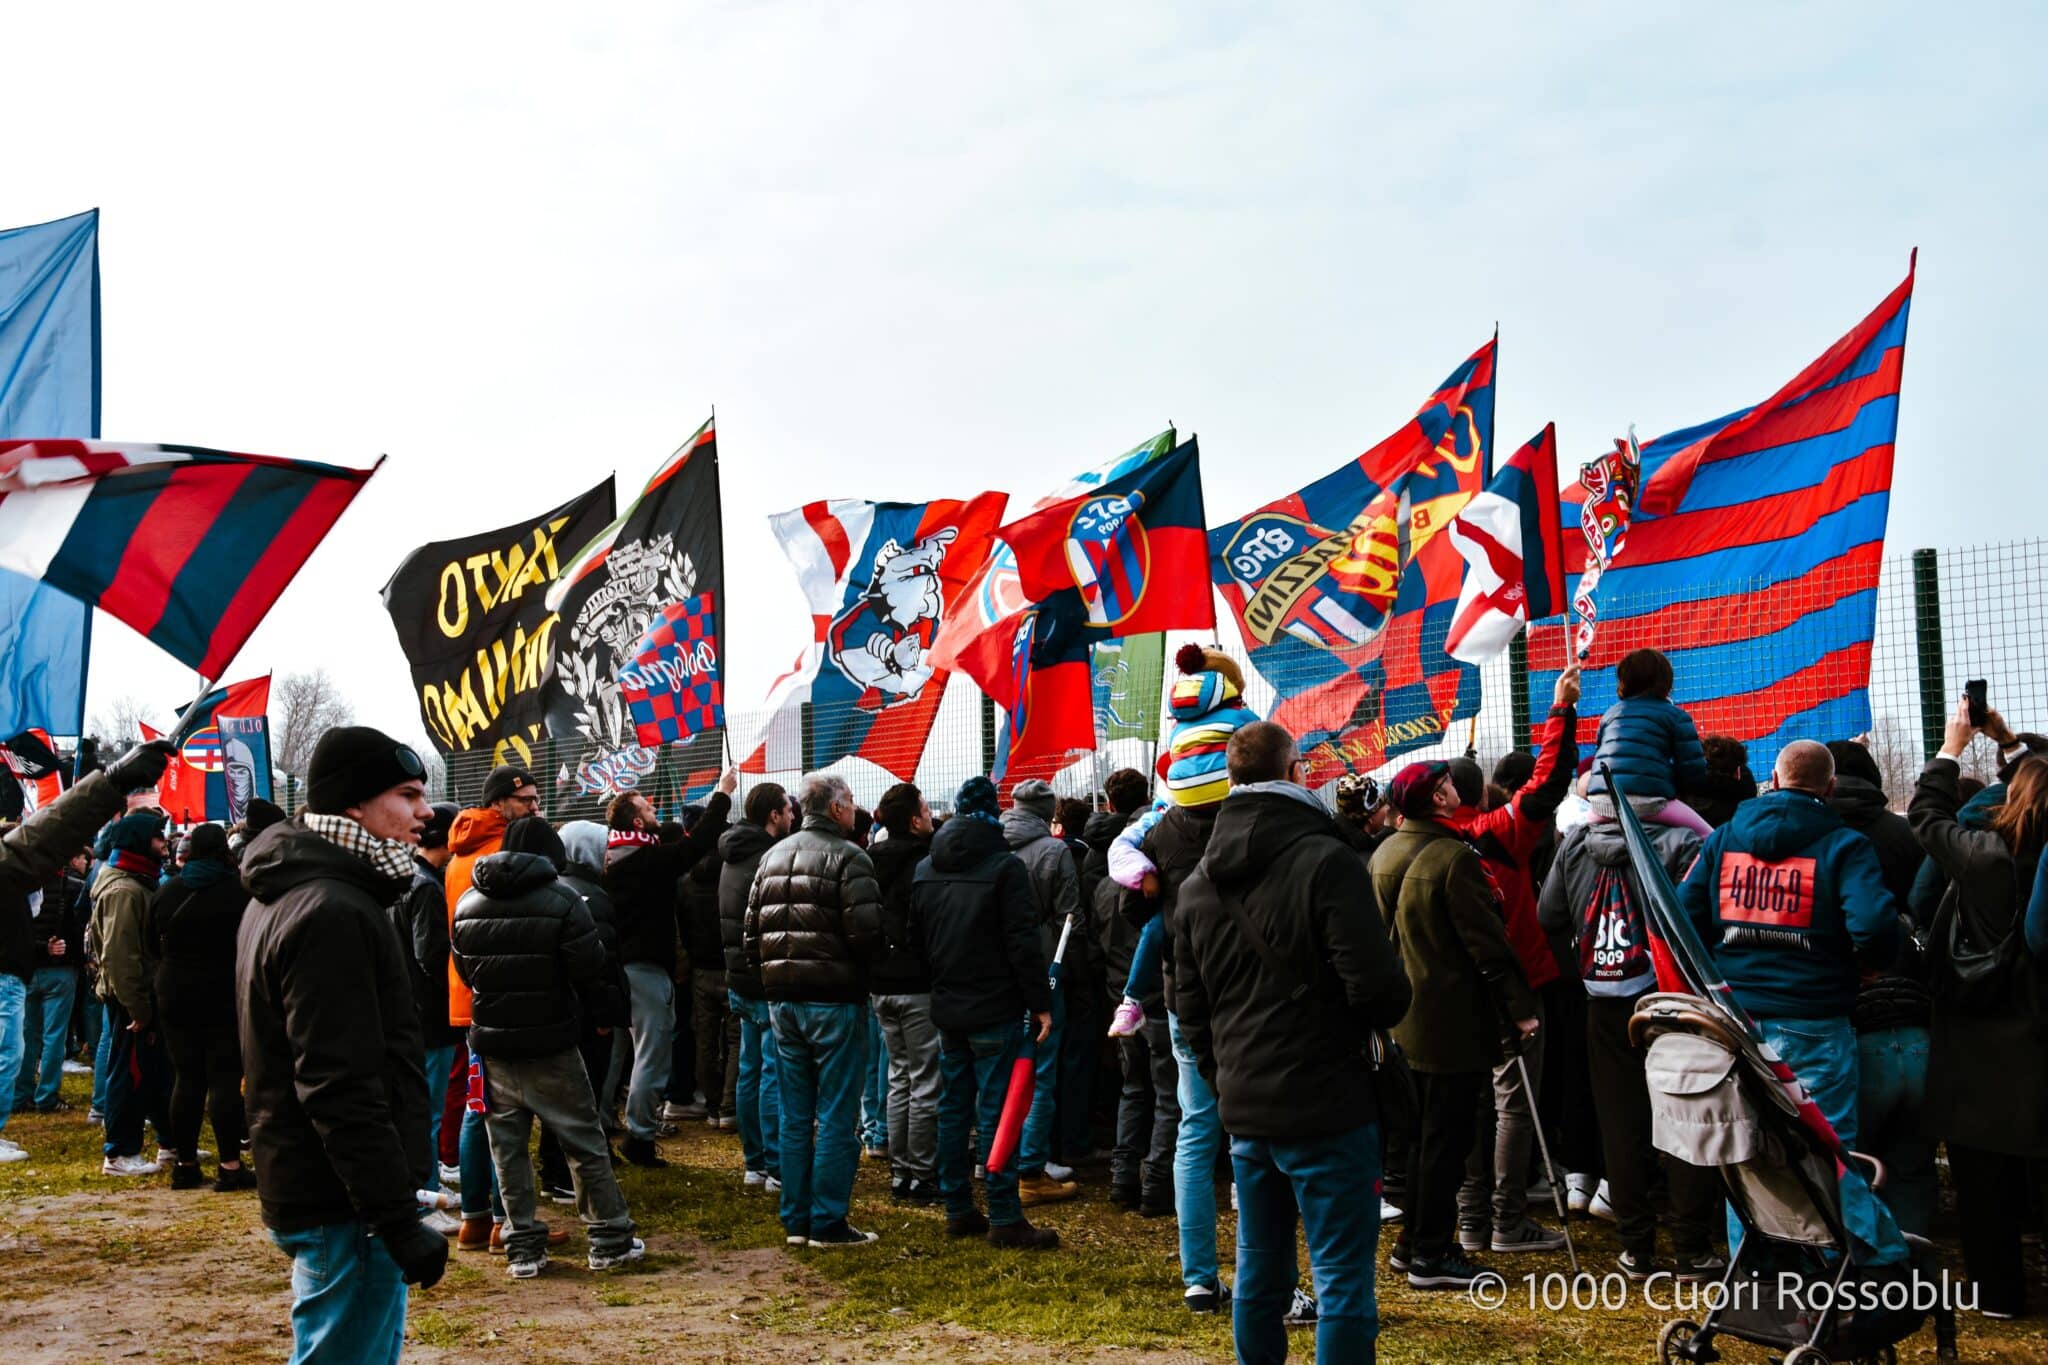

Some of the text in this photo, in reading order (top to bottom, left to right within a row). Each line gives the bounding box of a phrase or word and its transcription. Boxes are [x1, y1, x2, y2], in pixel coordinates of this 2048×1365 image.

[1730, 864, 1801, 914] 40059
[1593, 949, 1625, 966] 1909
[1595, 969, 1624, 977] macron
